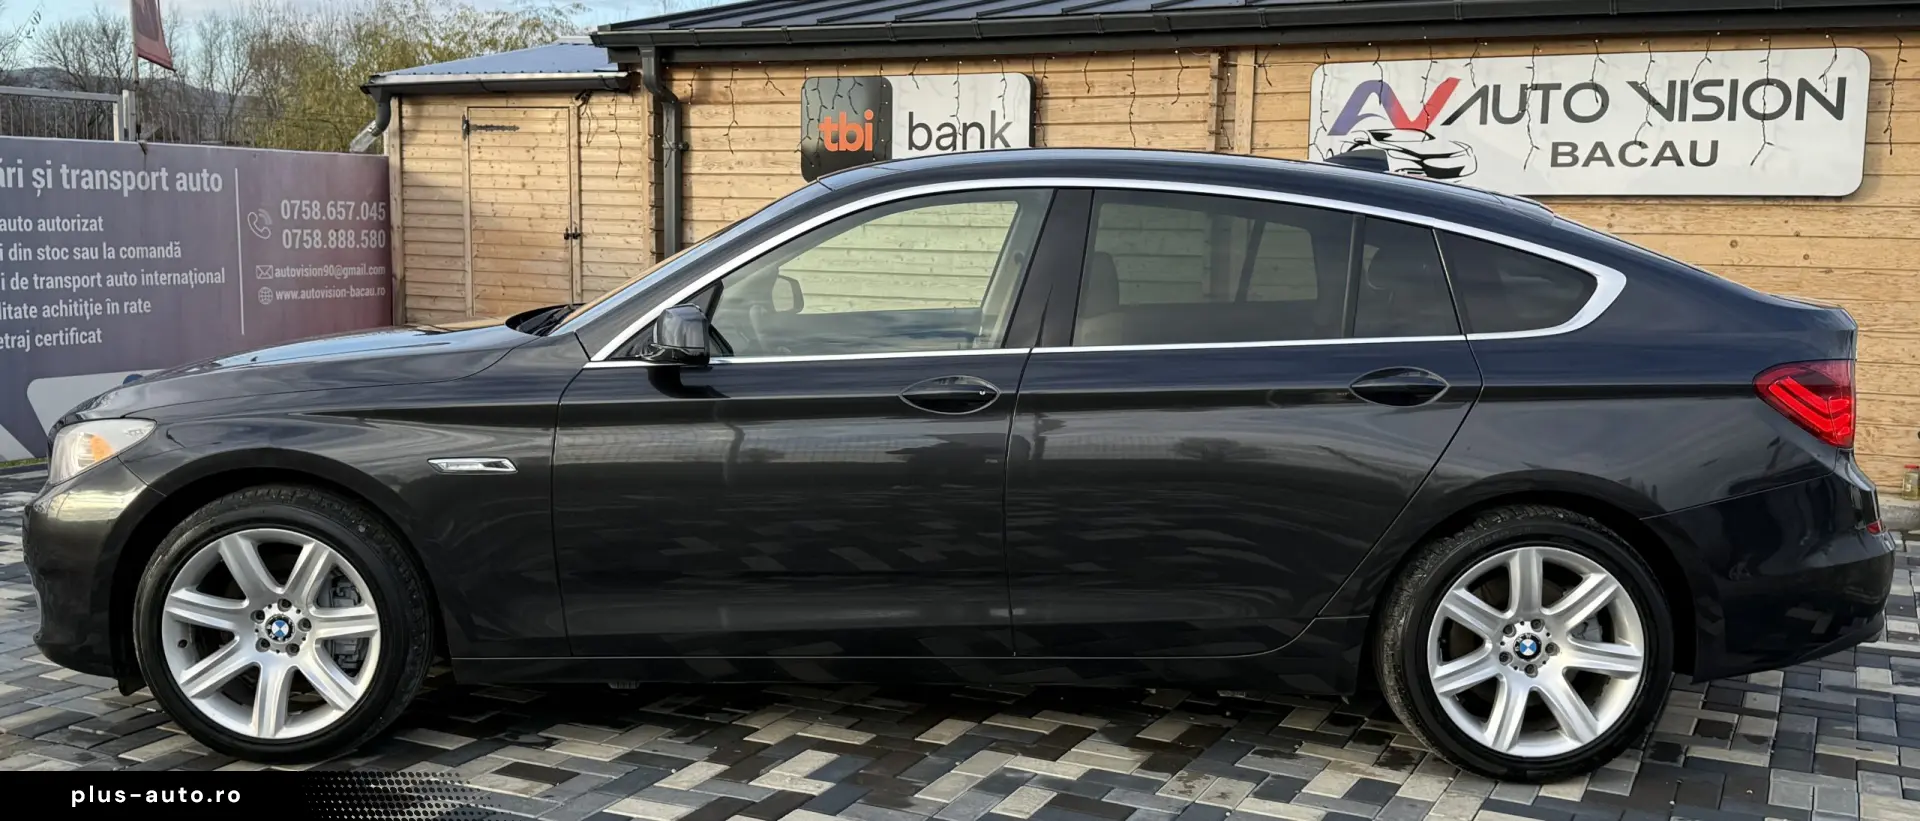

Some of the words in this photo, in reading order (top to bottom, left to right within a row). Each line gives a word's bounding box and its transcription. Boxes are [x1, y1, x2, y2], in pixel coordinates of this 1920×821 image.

[1440, 82, 1610, 126] AUTO
[1626, 76, 1847, 122] VISION
[818, 109, 874, 152] tbi
[908, 110, 1013, 151] bank
[1550, 140, 1719, 168] BACAU
[32, 159, 53, 197] și
[60, 163, 169, 198] transport
[175, 168, 223, 193] auto
[280, 199, 386, 220] 0758.657.045
[0, 215, 33, 232] auto
[37, 213, 104, 232] autorizat
[282, 229, 386, 249] 0758.888.580
[8, 242, 33, 261] din
[36, 245, 70, 260] stoc
[72, 247, 99, 260] sau
[102, 241, 116, 260] la
[119, 240, 182, 259] comandă
[10, 271, 29, 290] de
[33, 271, 103, 293] transport
[106, 271, 138, 287] auto
[274, 264, 386, 279] autovision90@gmail.com
[275, 284, 386, 301] www.autovision-bacau.ro
[105, 298, 121, 315] în
[123, 298, 152, 314] rate
[34, 326, 103, 347] certificat
